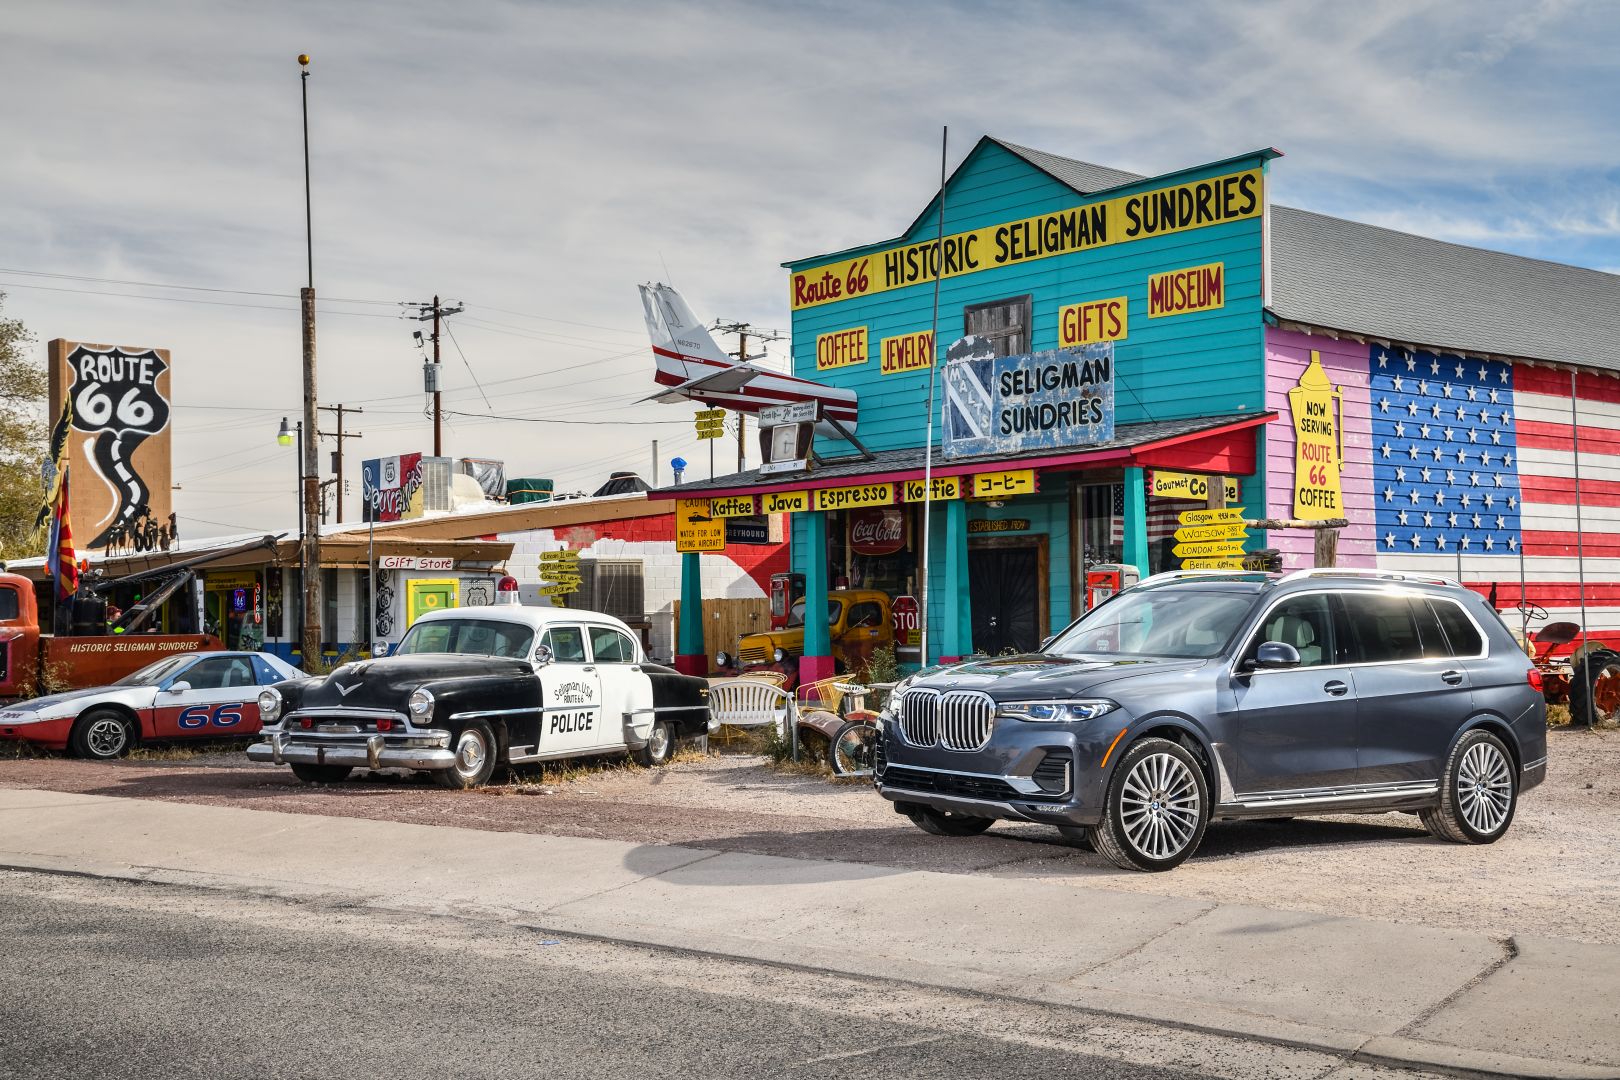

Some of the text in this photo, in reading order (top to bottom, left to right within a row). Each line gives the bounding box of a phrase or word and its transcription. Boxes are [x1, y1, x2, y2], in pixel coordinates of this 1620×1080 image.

[794, 173, 1257, 306] Route 66 HISTORIC SELIGMAN SUNDRIES
[1150, 266, 1222, 314] MUSEUM
[1063, 301, 1121, 344] GIFTS
[818, 329, 865, 367] COFFEE
[882, 333, 934, 371] JEWELRY
[80, 355, 154, 385] ROUTE
[1000, 357, 1110, 398] SELIGMAN
[76, 382, 154, 427] 66
[950, 367, 990, 428] MALTS
[1000, 398, 1103, 435] SUNDRIES
[1306, 401, 1326, 417] NOW
[1300, 418, 1332, 437] SERVING
[1302, 442, 1332, 464] ROUTE
[981, 475, 1026, 491] コーヒー
[1156, 478, 1188, 491] Gourmet
[1309, 465, 1327, 486] 66
[820, 486, 888, 508] Espresso
[908, 479, 955, 500] Kofie
[1300, 487, 1336, 509] COFFEE
[712, 499, 752, 516] Kaffee
[769, 494, 802, 512] Java
[970, 520, 1008, 531] ESTABLISHED
[1186, 512, 1213, 523] Glasgow
[680, 530, 694, 538] WATCH
[852, 518, 904, 543] Coca-Cola
[1182, 528, 1226, 539] Warsaw
[680, 538, 721, 548] FLYING AIRCRAFT
[384, 557, 452, 568] Gift Store
[1190, 561, 1212, 570] Berlin
[70, 641, 199, 653] HISTORIC SELIGMAN SUNDRIES
[564, 694, 585, 703] ROUTE 66
[178, 702, 243, 730] 66
[550, 712, 594, 734] POLICE
